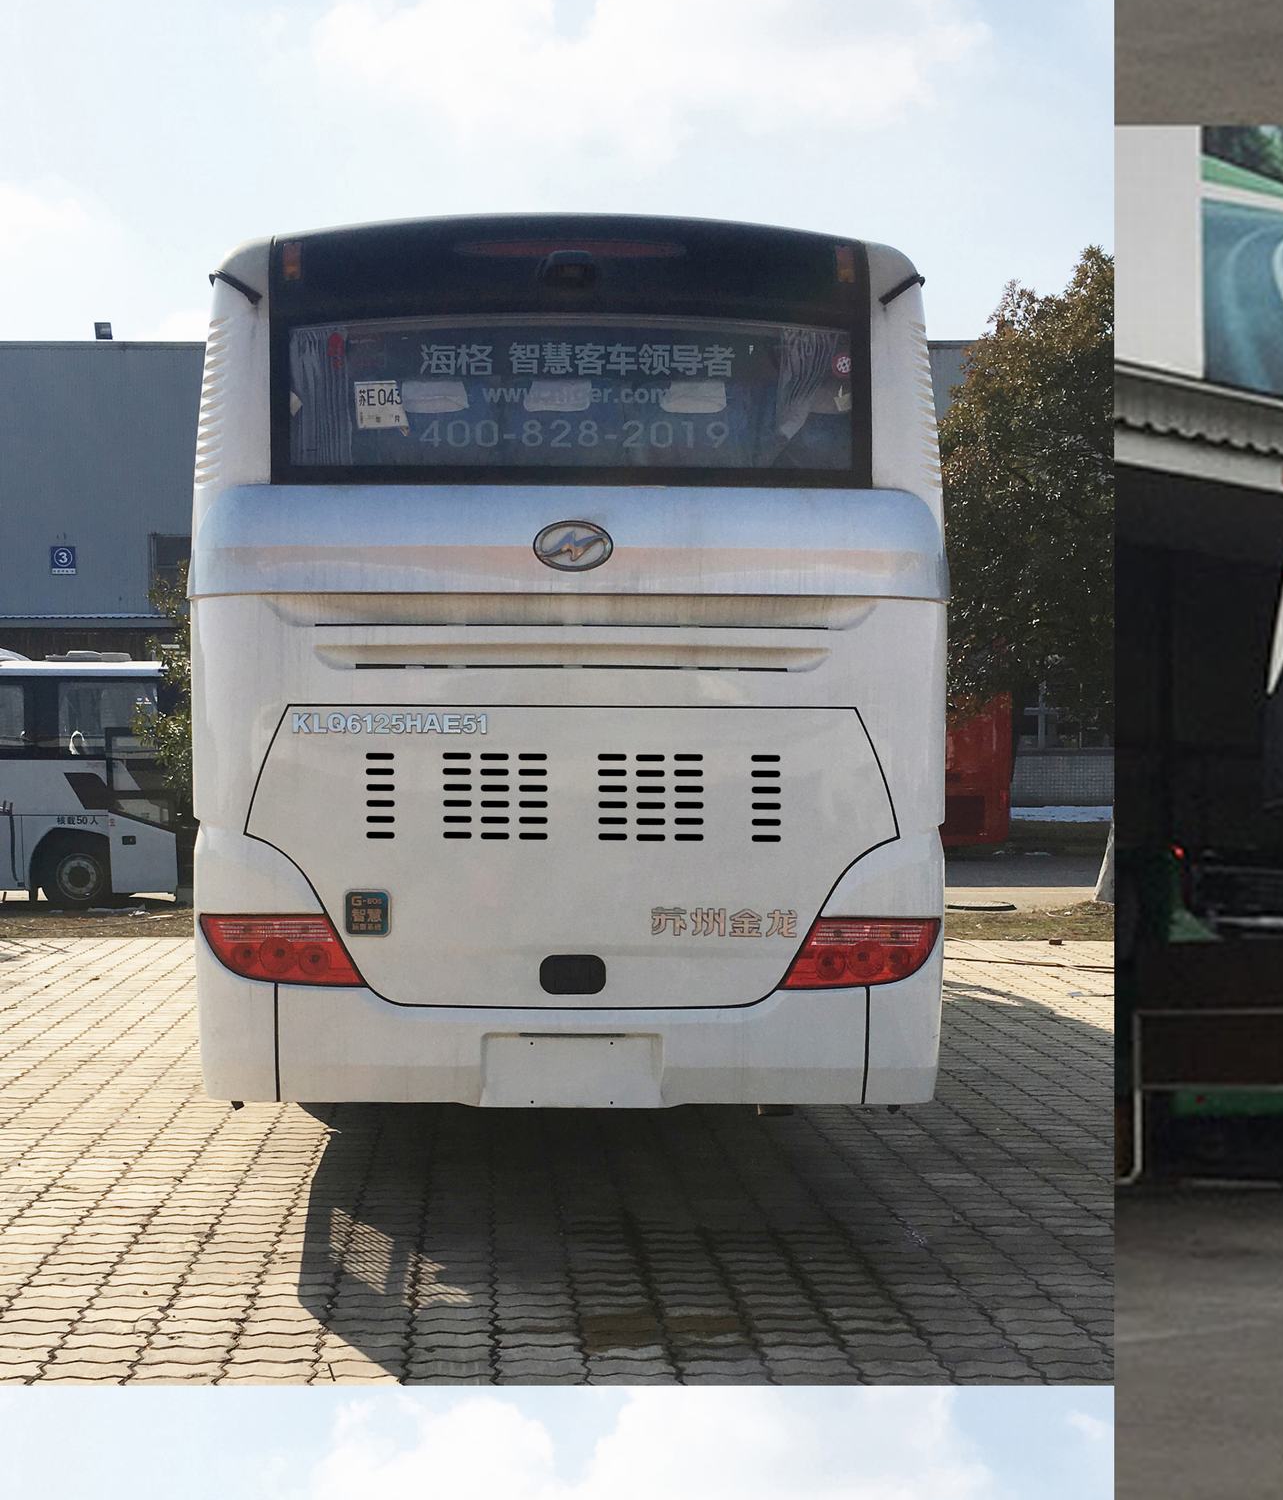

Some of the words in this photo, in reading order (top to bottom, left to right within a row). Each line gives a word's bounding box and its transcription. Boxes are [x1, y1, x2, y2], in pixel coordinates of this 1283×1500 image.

[420, 345, 493, 376] 海格
[509, 342, 735, 377] 智慧客车领导者
[420, 420, 729, 448] 400-828-2019
[292, 713, 488, 735] KLQ6125HAE51
[651, 907, 798, 938] 苏州金龙
